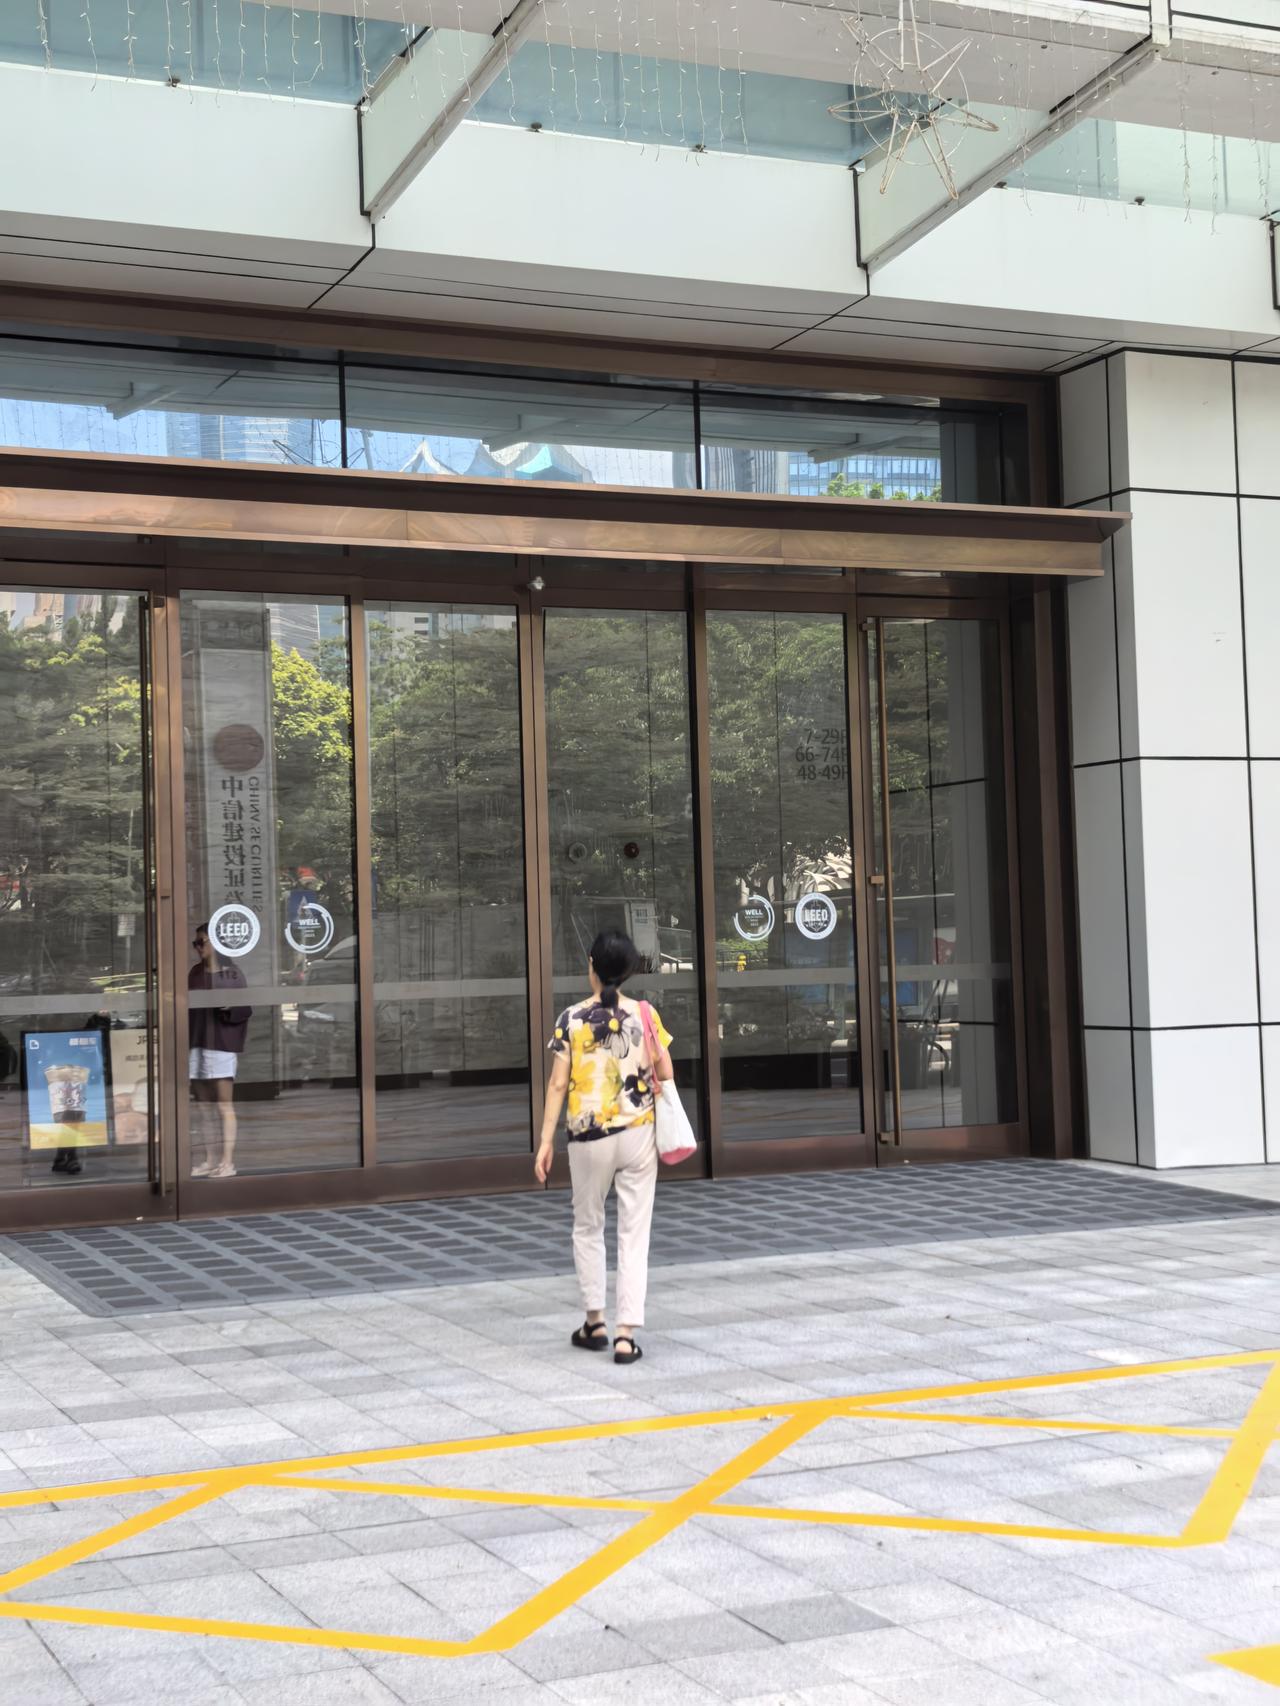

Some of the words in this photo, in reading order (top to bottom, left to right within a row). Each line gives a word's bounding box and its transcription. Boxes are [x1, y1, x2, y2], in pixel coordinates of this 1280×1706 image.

[299, 918, 321, 926] WELL
[804, 908, 828, 922] LEED
[220, 922, 249, 937] LEED
